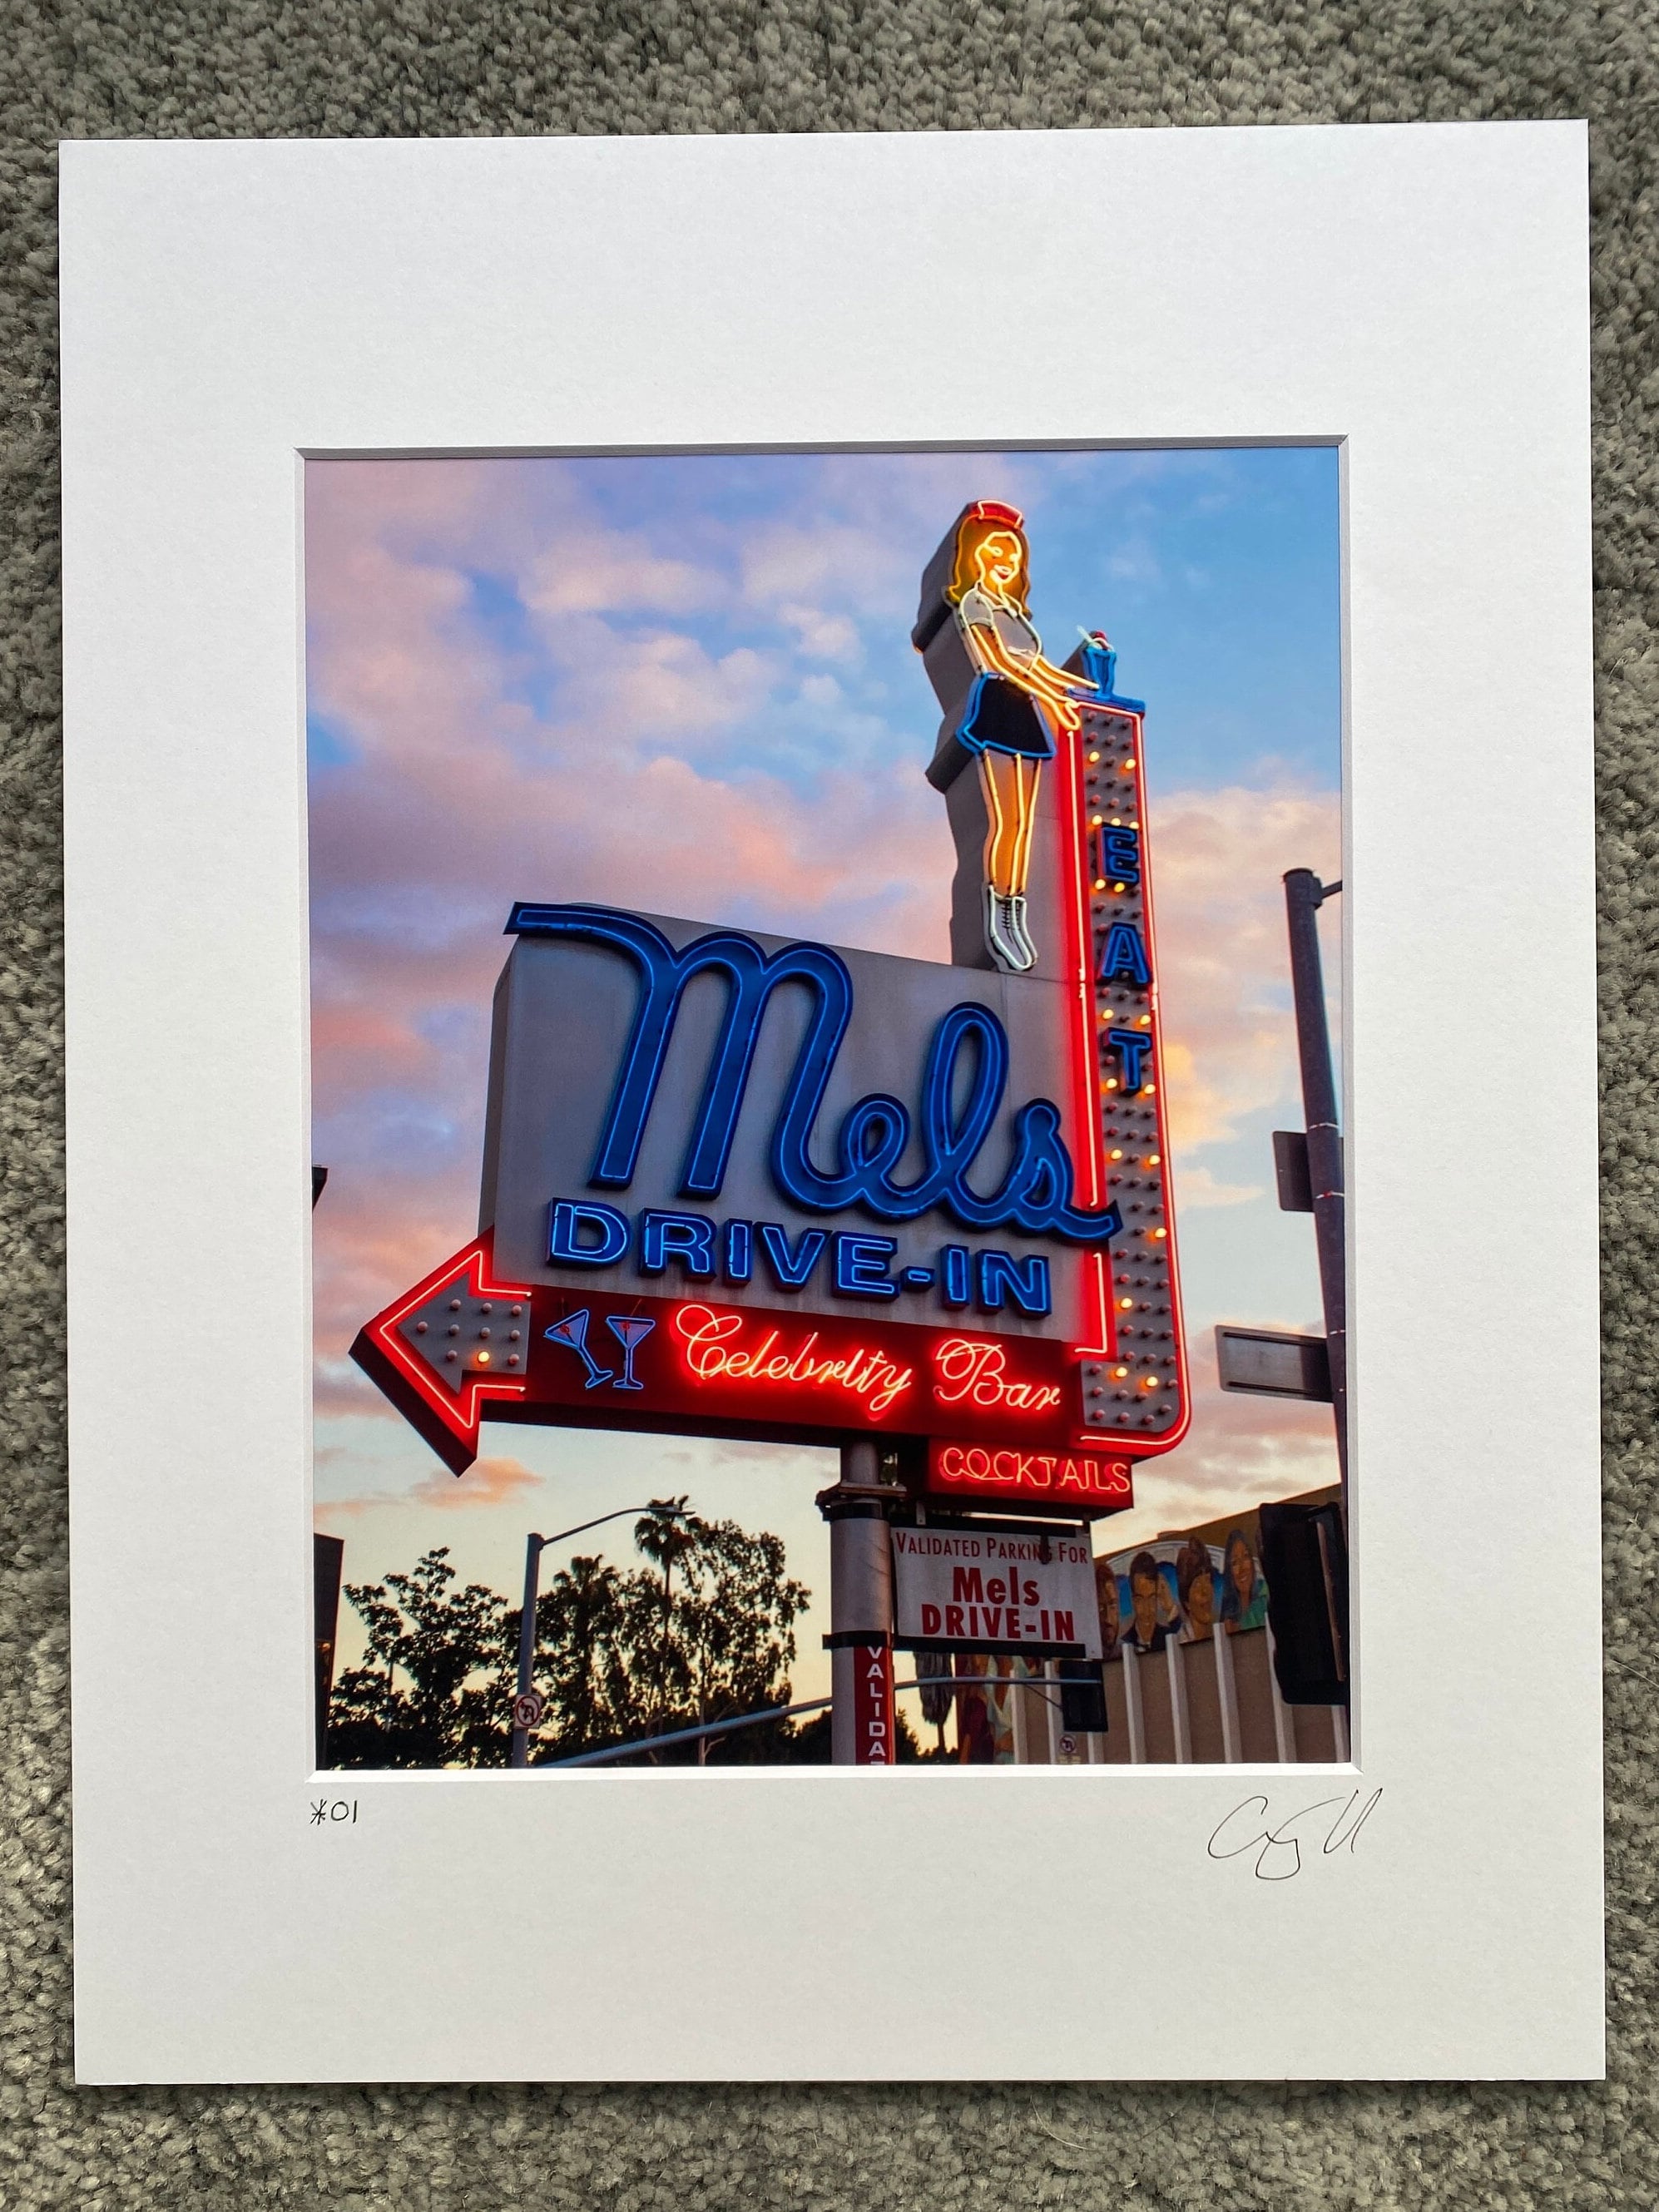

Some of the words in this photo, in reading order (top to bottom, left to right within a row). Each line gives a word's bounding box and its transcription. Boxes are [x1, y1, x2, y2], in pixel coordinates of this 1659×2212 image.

[1097, 822, 1151, 1095] EAT
[503, 901, 1122, 1242] Mels
[546, 1196, 1053, 1320] DRIVE-IN
[675, 1304, 914, 1413] Celebrity
[934, 1337, 1062, 1411] Bar
[940, 1447, 1132, 1493] COCKTAILS
[921, 1603, 1076, 1642] DRIVE-IN
[953, 1566, 1040, 1606] Mels
[866, 1645, 887, 1766] VALIDA
